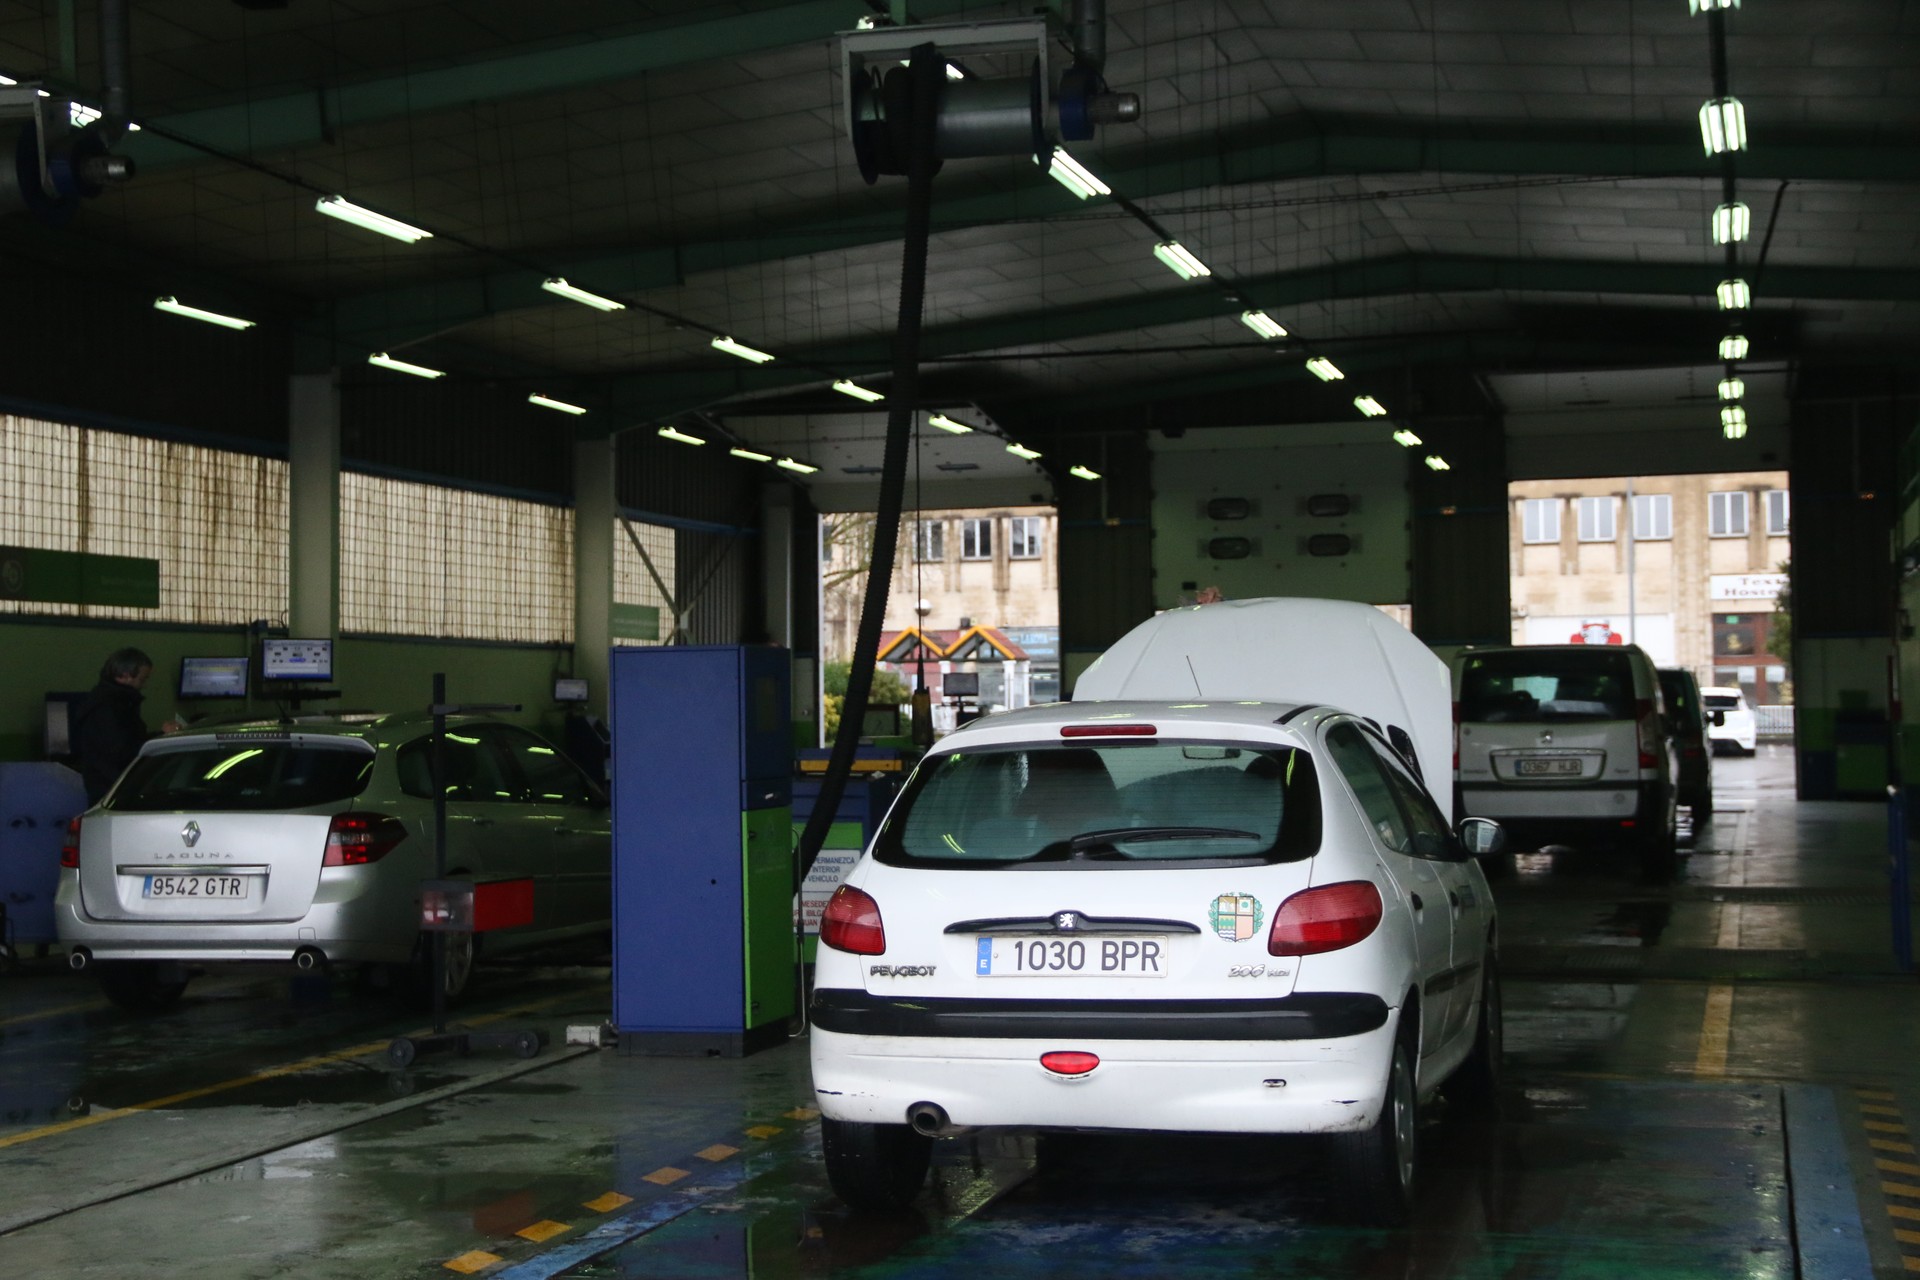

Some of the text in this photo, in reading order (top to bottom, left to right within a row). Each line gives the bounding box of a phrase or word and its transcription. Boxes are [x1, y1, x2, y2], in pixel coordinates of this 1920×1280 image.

[153, 852, 234, 860] LAGUNA
[152, 877, 242, 896] 9542 GTR
[980, 940, 1161, 972] E 1030 BPR
[870, 965, 937, 977] PEUGEOT
[1228, 964, 1266, 978] 206
